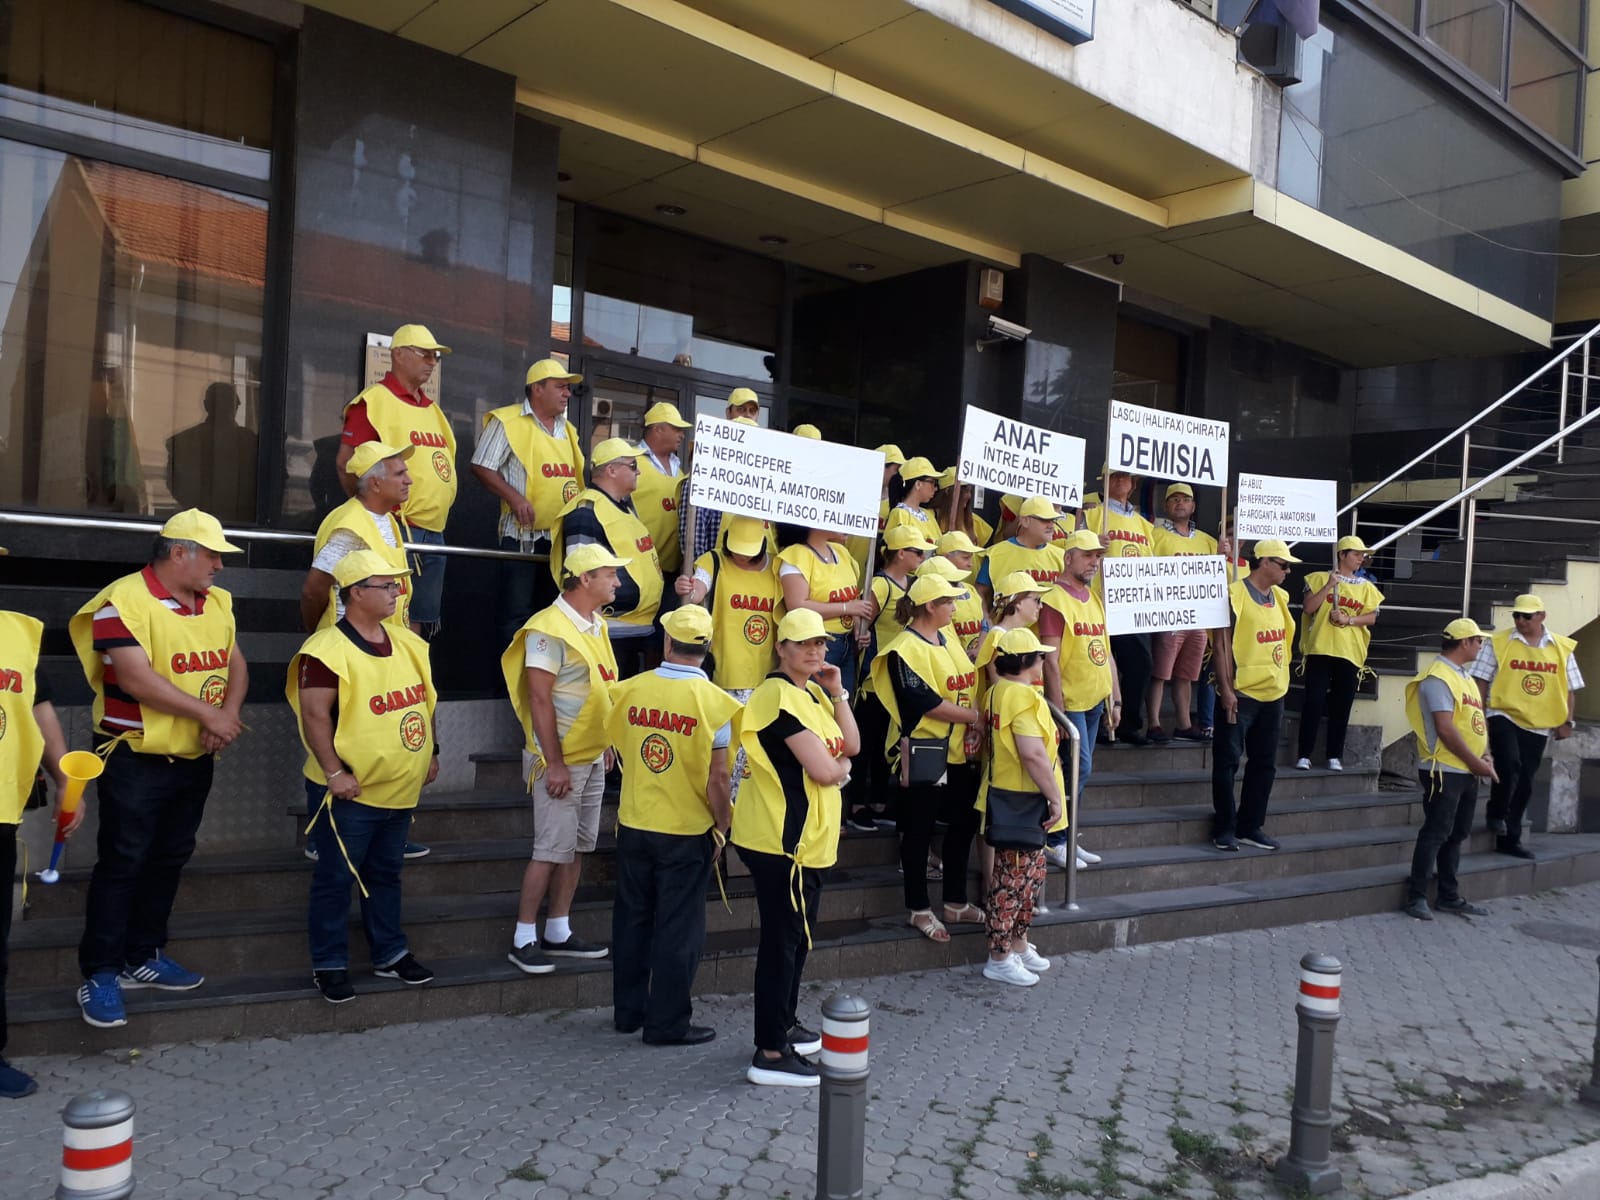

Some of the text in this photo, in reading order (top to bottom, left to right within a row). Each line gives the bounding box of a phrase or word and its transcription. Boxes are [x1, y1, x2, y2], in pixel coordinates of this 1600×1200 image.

[1112, 405, 1141, 424] LASCU
[1142, 412, 1184, 435] (HALIFAX)
[696, 419, 746, 444] A= ABUZ
[993, 419, 1051, 455] ANAF
[695, 441, 792, 475] N= NEPRICEPERE
[983, 441, 1059, 478] ÎNTRE ABUZ
[1120, 432, 1215, 481] DEMISIA
[692, 462, 708, 476] A=
[779, 481, 846, 505] AMATORISM
[1247, 479, 1263, 489] ABUZ
[691, 483, 705, 497] F=
[707, 487, 774, 515] FANDOSELI,
[776, 501, 820, 523] FIASCO,
[823, 509, 877, 531] FALIMENT
[1247, 494, 1286, 506] NEPRICEPERE
[1280, 511, 1316, 522] AMATORISM
[1304, 527, 1336, 537] FALIMENT
[1104, 563, 1133, 578] LASCU
[1135, 562, 1179, 581] (HALIFAX)
[1153, 582, 1163, 602] ÎN
[1166, 584, 1223, 601] PREJUDICII
[1326, 593, 1364, 610] GRANT
[1134, 609, 1196, 628] MINCINOASE
[1509, 659, 1557, 674] GARANT
[628, 706, 697, 736] GARANT
